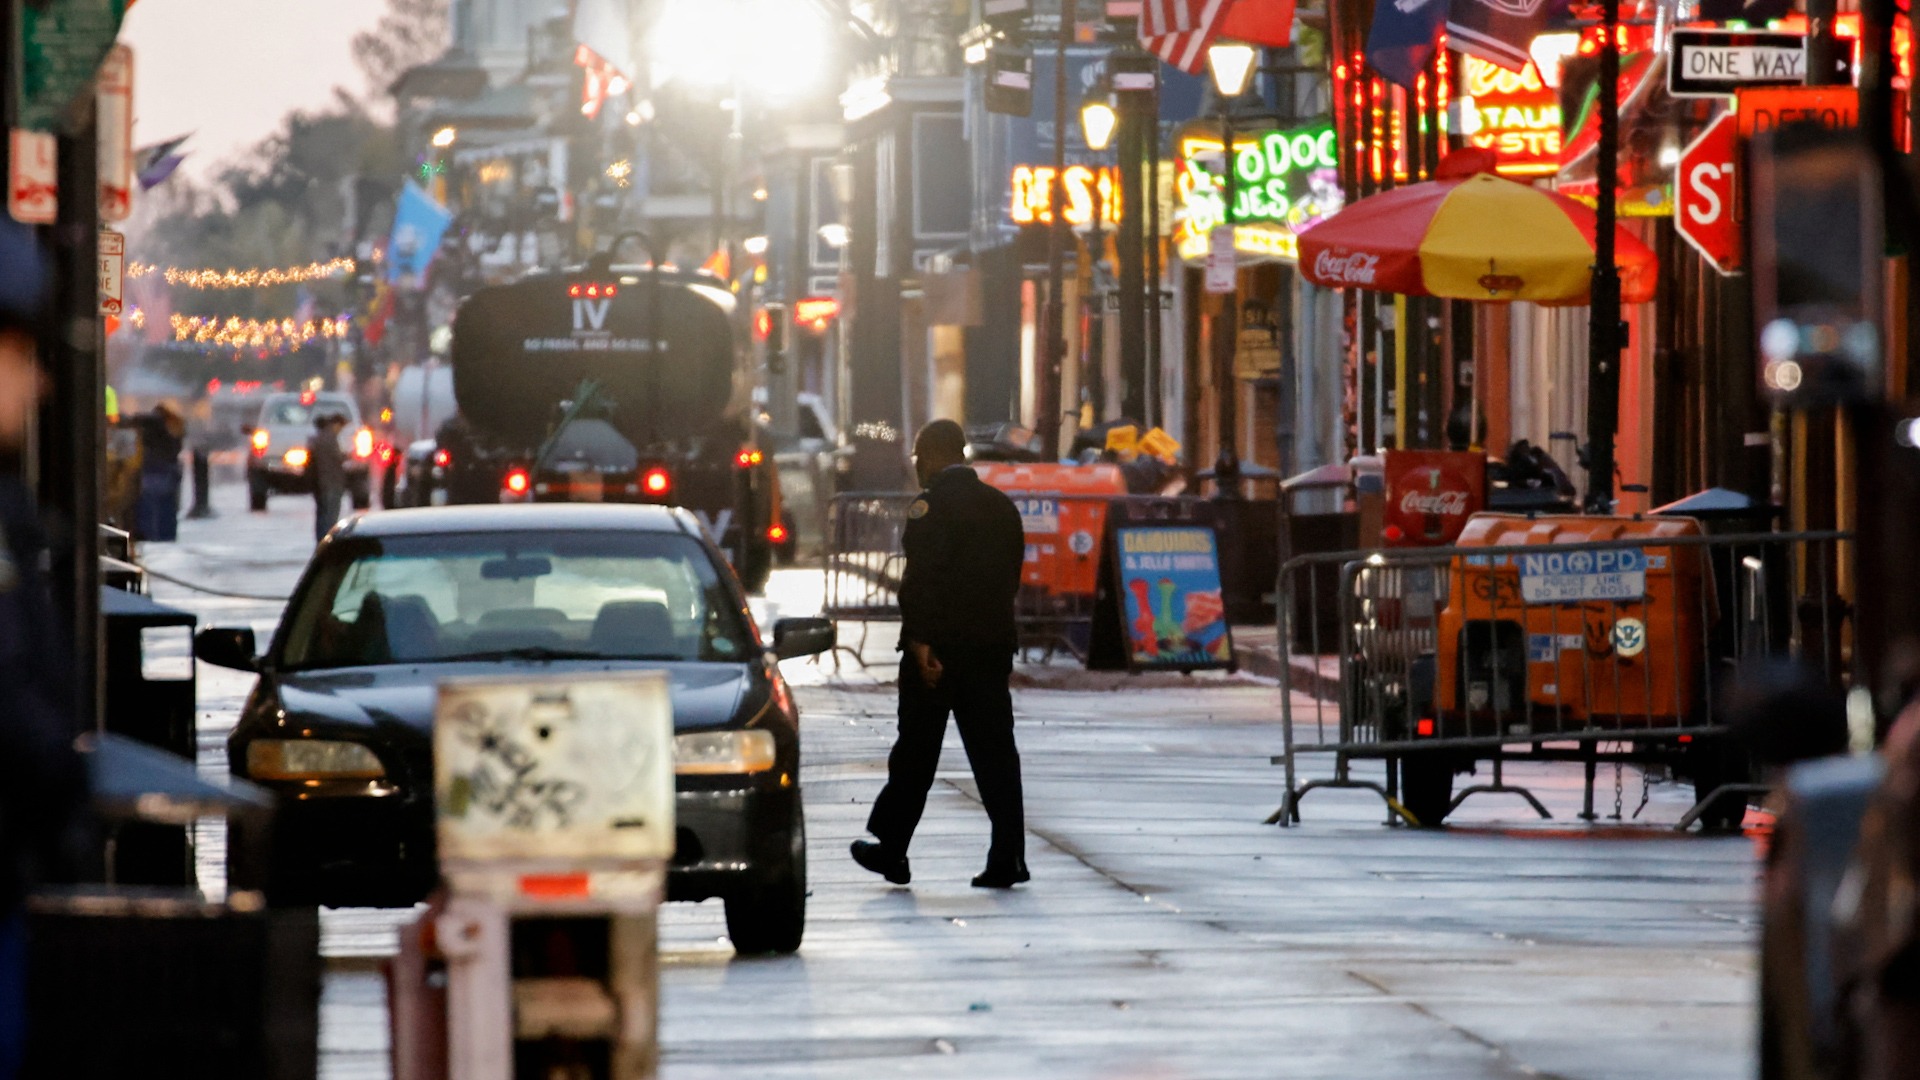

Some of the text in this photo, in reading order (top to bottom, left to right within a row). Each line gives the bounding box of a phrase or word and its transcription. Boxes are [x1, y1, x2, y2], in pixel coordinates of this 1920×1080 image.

[1690, 51, 1801, 77] ONE WAY
[572, 299, 612, 330] IV
